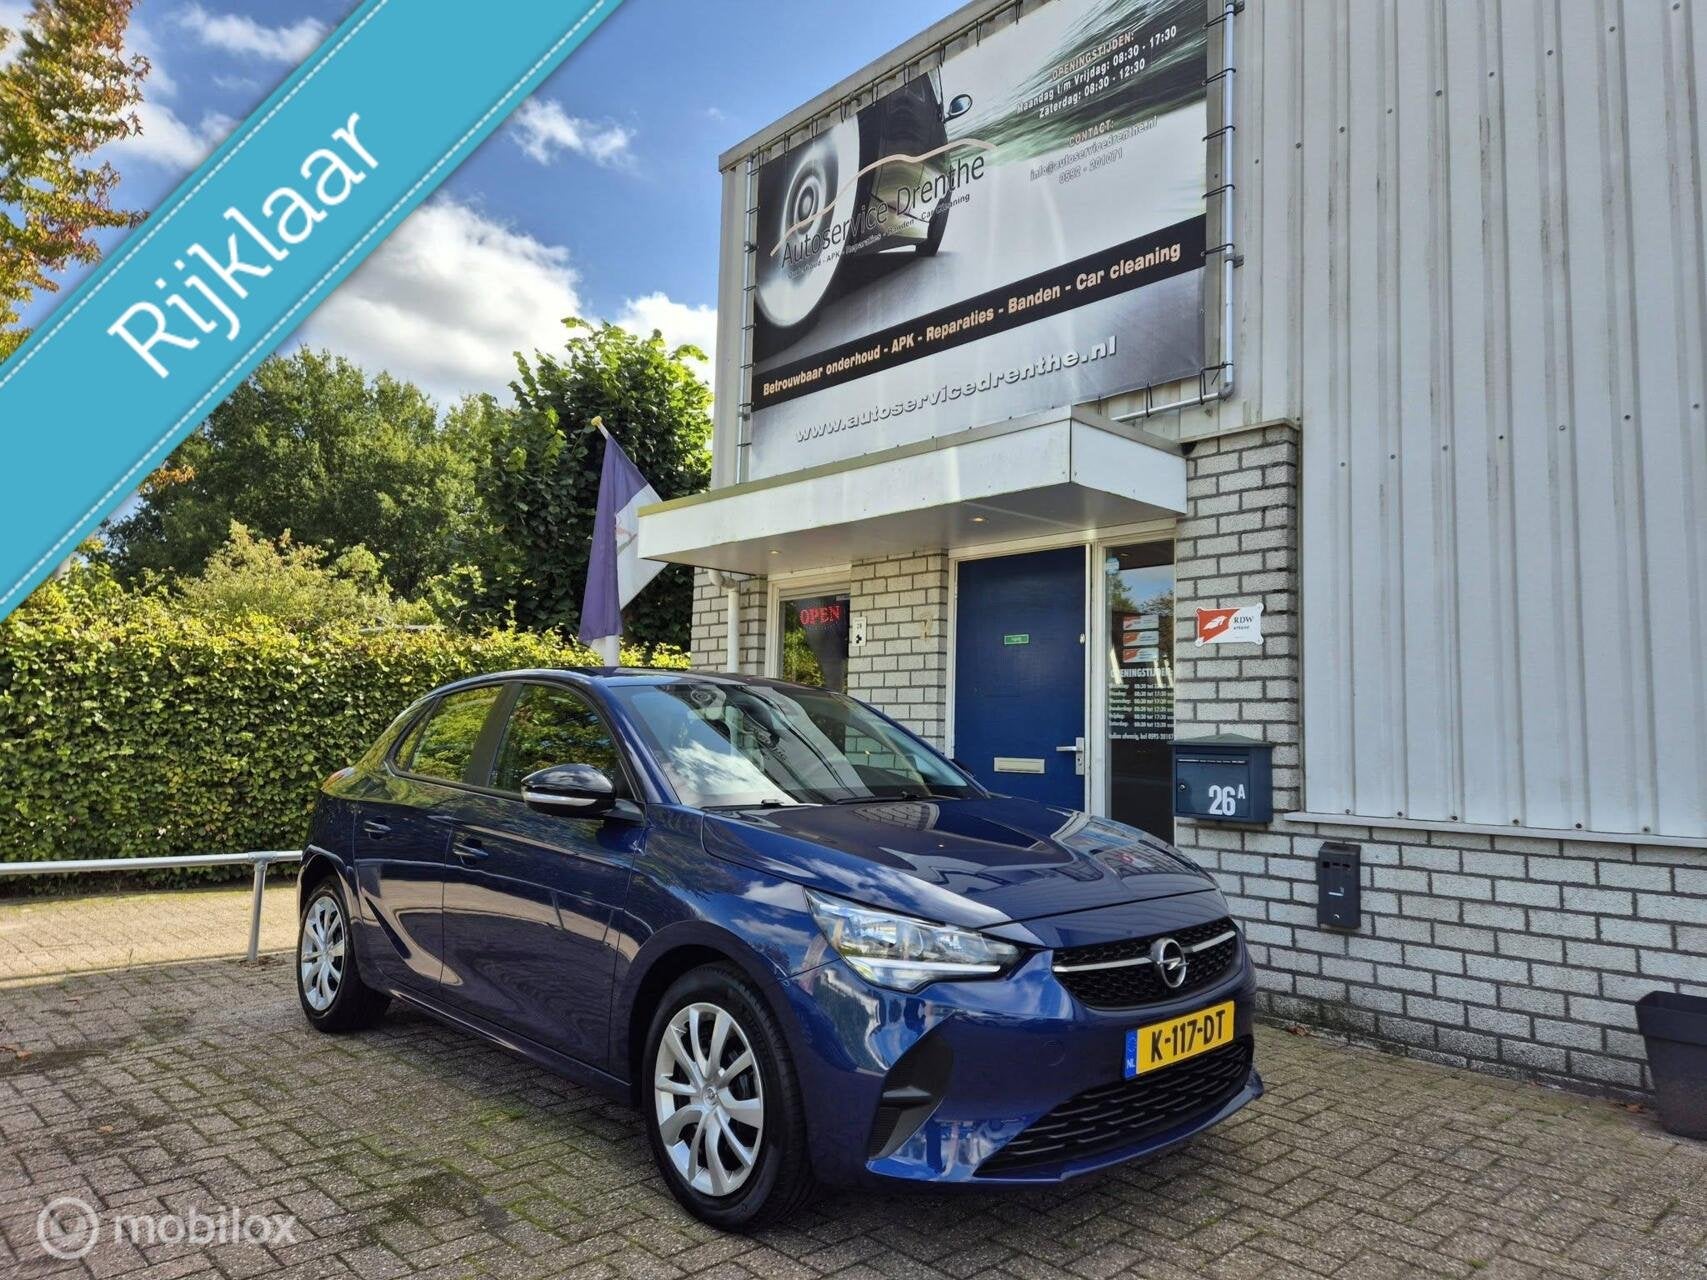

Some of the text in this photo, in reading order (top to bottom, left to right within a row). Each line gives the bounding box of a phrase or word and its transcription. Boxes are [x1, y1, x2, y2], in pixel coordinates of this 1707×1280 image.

[1052, 31, 1135, 81] OPENINGSTIJDEN:
[1074, 62, 1110, 86] Vrijdag:
[1113, 44, 1139, 67] 08:30
[1150, 25, 1177, 49] 17:30
[1039, 91, 1081, 119] Zaterdag:
[1084, 75, 1110, 98] 08:30
[1119, 58, 1146, 81] 12:30
[1068, 119, 1114, 147] CONTACT:
[781, 155, 985, 268] Autoservice Drenthe
[763, 366, 823, 397] Betrouwbaar
[826, 345, 881, 376] onderhoud
[891, 332, 915, 354] APK
[926, 307, 994, 341] Reparaties
[1008, 283, 1060, 314] Banden
[1076, 269, 1105, 291] Car
[1110, 242, 1181, 280] cleaning
[796, 335, 1118, 443] www.autoservicedrenthe.nl
[800, 604, 841, 625] OPEN
[1233, 616, 1253, 624] RDW
[1151, 1009, 1225, 1063] K-117-DT
